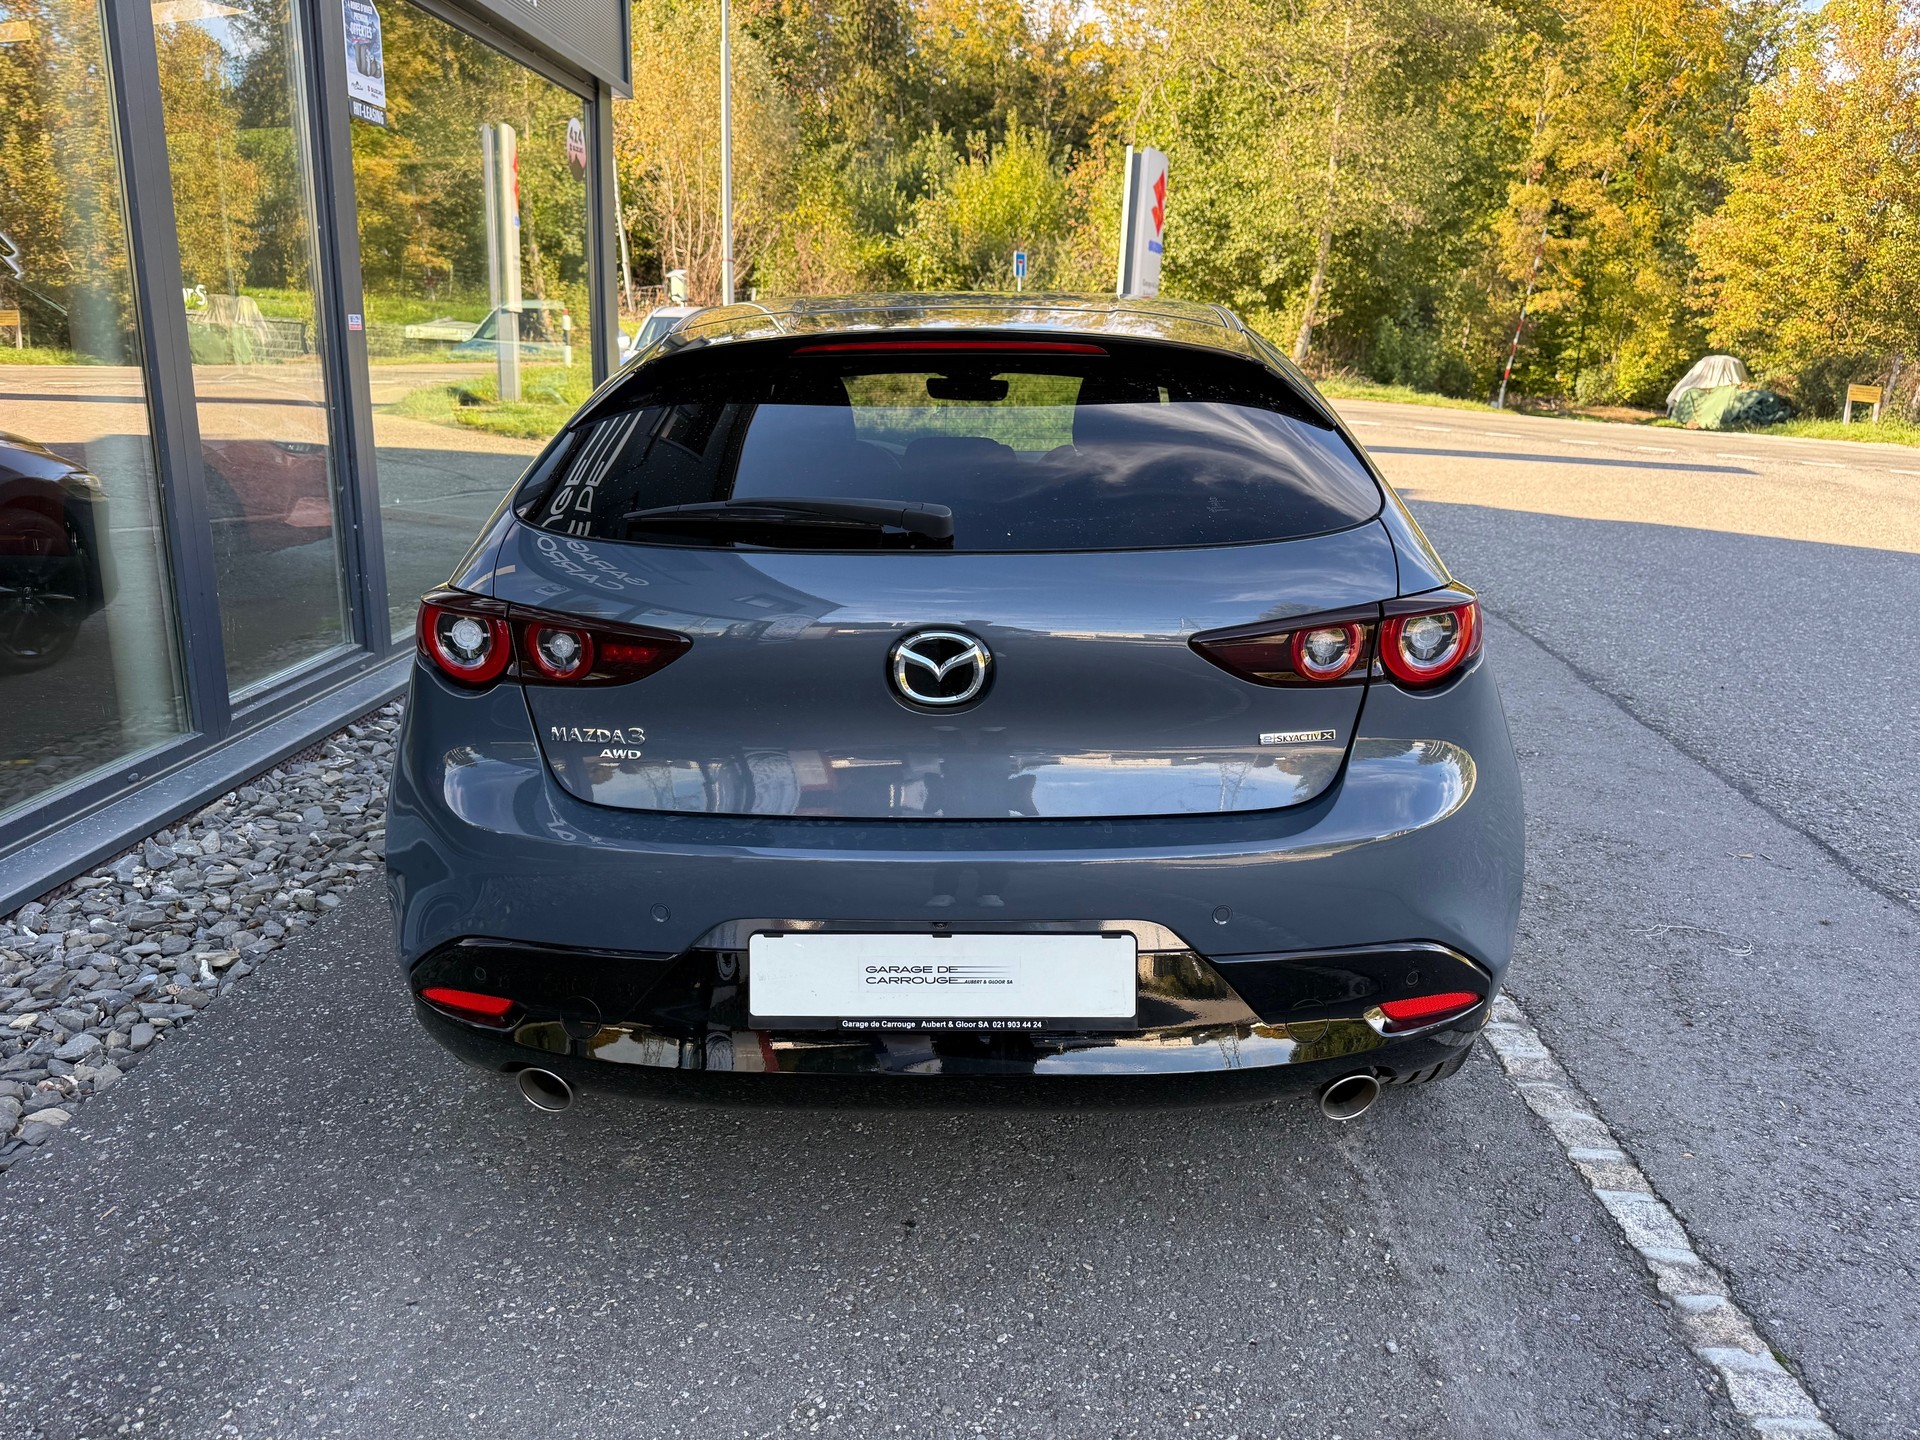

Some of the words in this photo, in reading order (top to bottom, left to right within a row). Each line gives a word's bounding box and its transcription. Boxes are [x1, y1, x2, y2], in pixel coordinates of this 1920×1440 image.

[350, 21, 373, 40] OFFERTES
[353, 100, 384, 125] HIT-LEASING
[551, 726, 646, 745] MAZDA3
[599, 748, 642, 760] AWD
[865, 965, 933, 974] GARAGE
[937, 965, 959, 974] DE
[865, 976, 961, 985] CARROUGE
[842, 1020, 869, 1029] Garage
[870, 1020, 880, 1028] de
[881, 1020, 916, 1030] Carrouge
[921, 1020, 947, 1028] Aubert
[947, 1020, 954, 1028] &
[955, 1020, 976, 1028] Gloor
[978, 1020, 990, 1028] SA
[992, 1020, 1005, 1028] 021
[1007, 1020, 1020, 1028] 903
[1022, 1020, 1031, 1028] 44
[1033, 1020, 1042, 1028] 24
